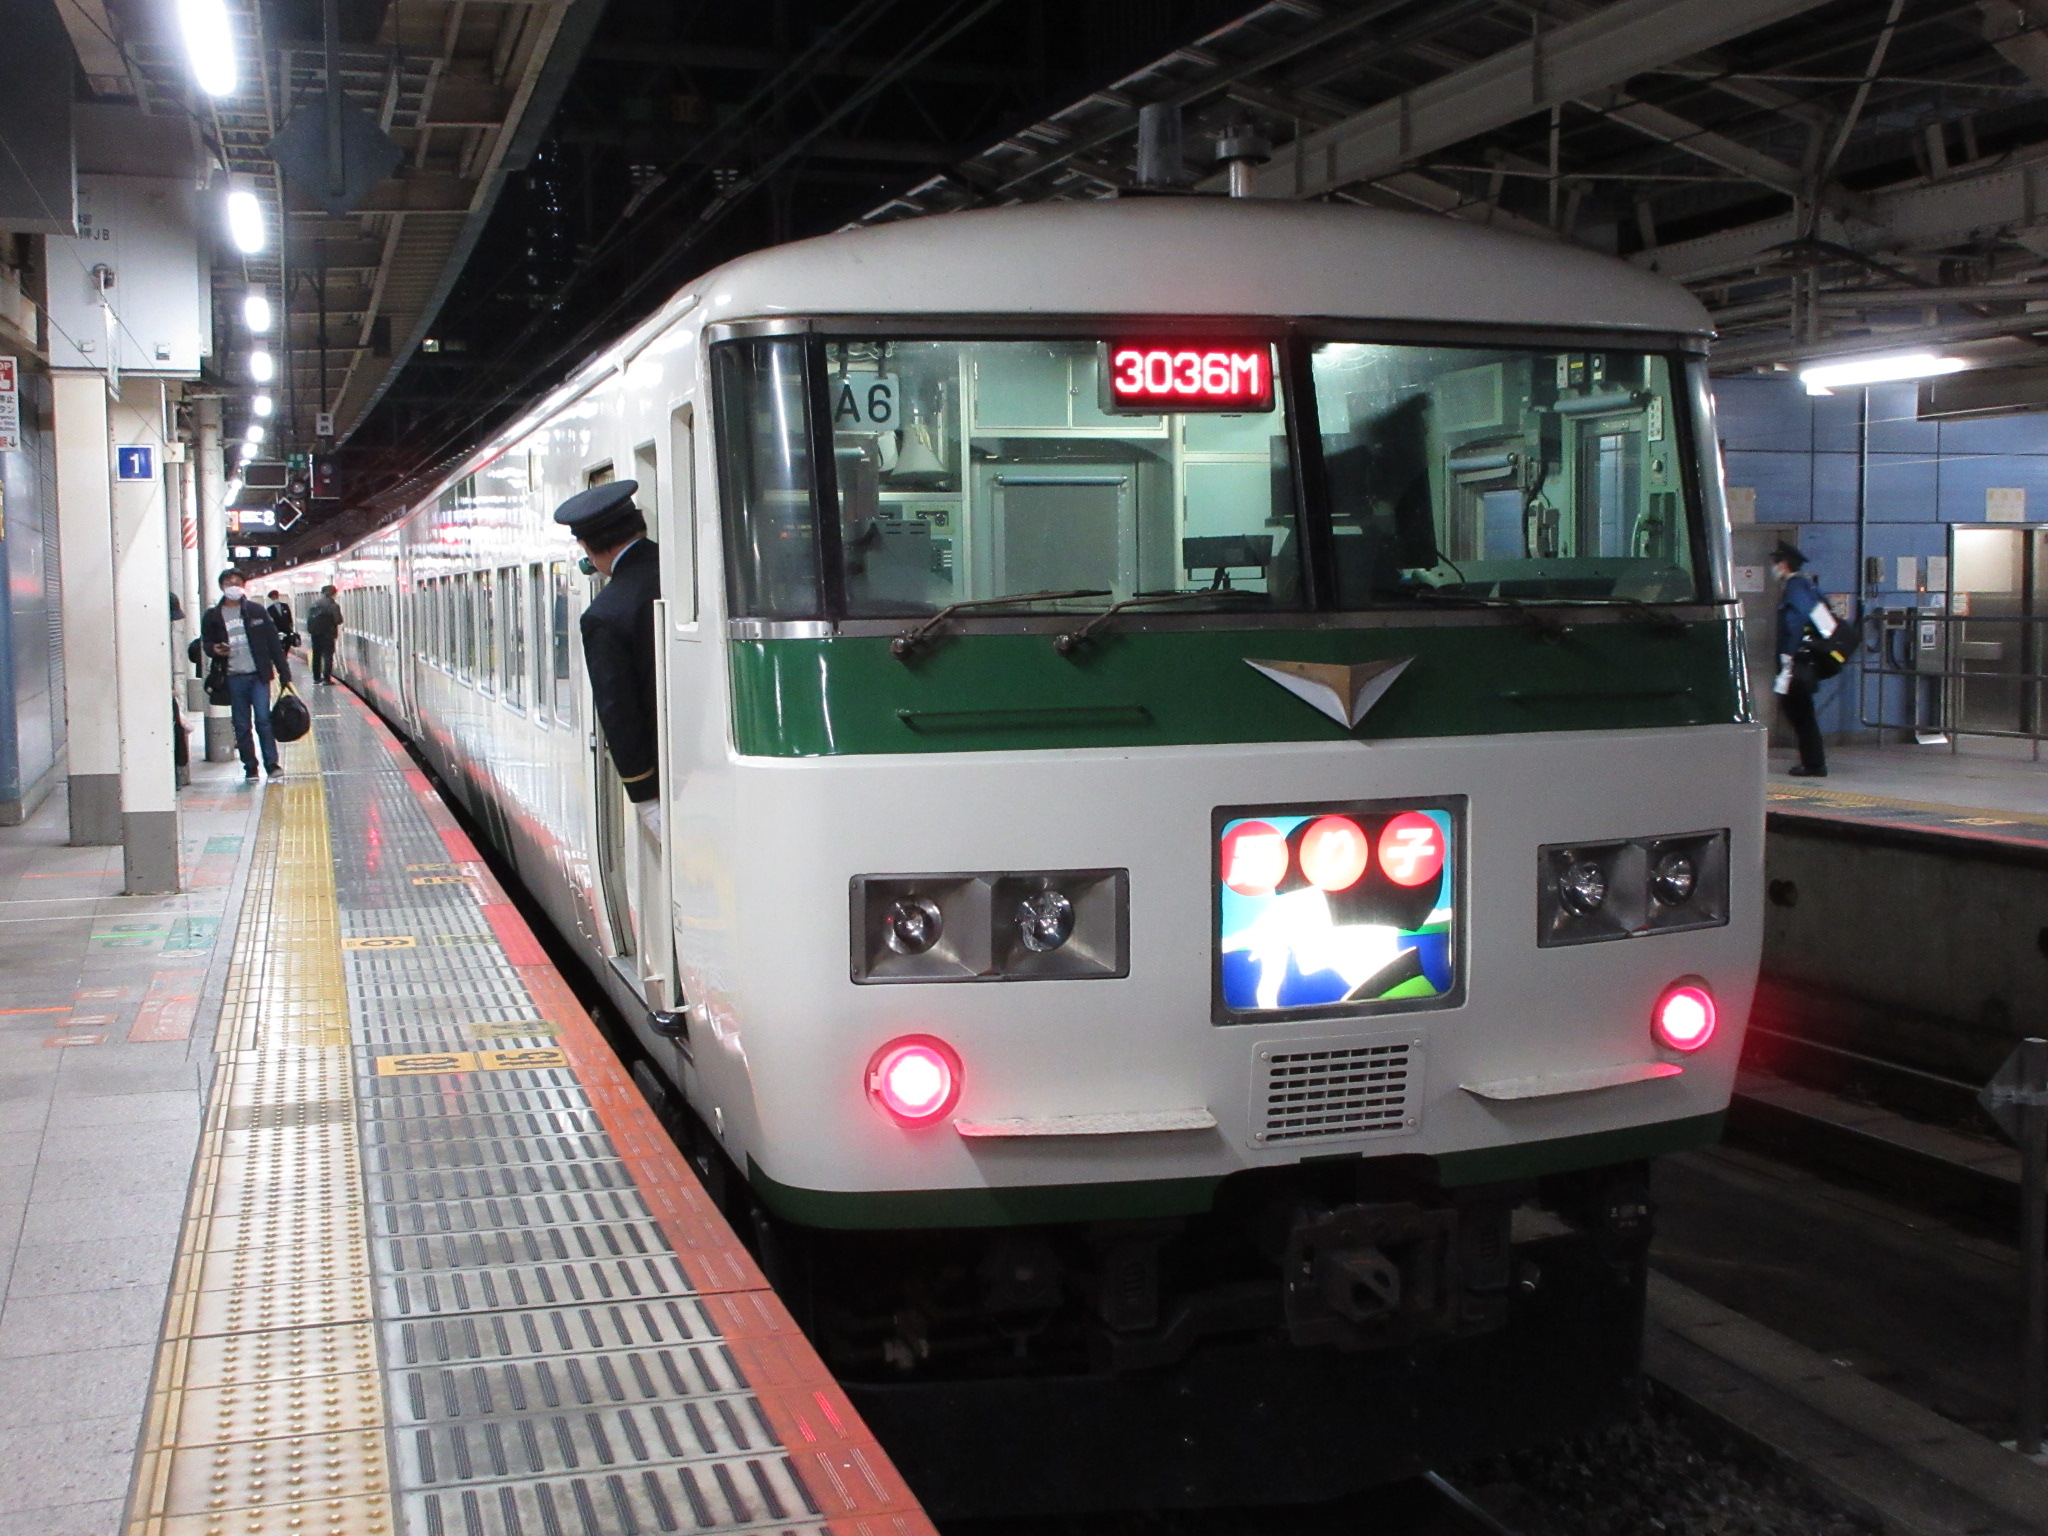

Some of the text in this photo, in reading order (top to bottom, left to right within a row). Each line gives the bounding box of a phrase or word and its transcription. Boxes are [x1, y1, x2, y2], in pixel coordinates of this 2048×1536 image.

[1115, 351, 1258, 395] 3036M
[835, 384, 892, 423] A6
[130, 453, 140, 474] 1
[394, 1055, 460, 1072] 10
[495, 1050, 562, 1067] 15
